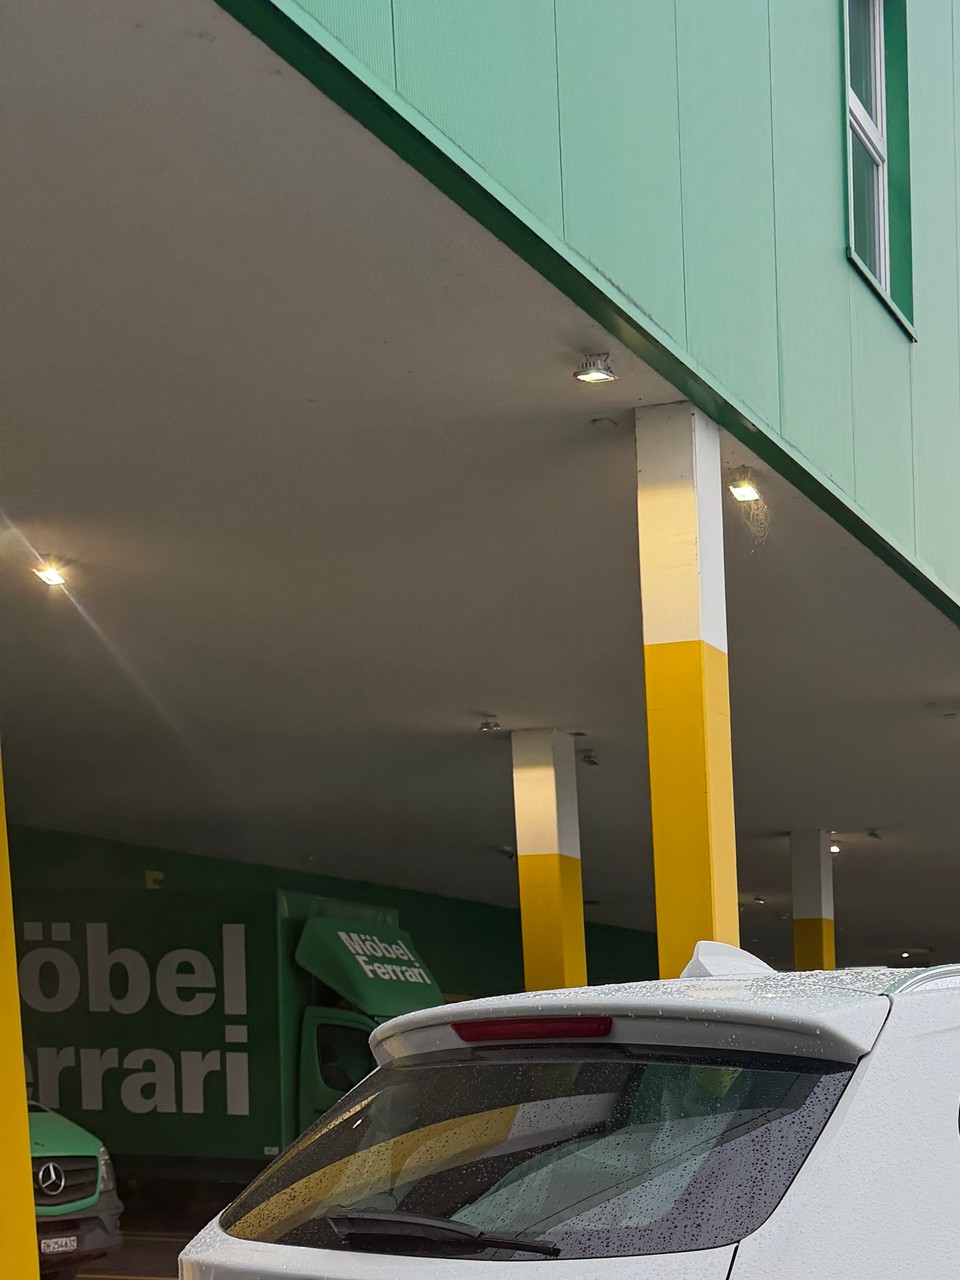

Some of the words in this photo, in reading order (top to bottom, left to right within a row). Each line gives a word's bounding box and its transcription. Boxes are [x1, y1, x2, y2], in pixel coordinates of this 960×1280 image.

[20, 922, 248, 1015] öbel
[338, 931, 414, 962] Möbel
[355, 955, 431, 985] Ferrari
[24, 1025, 250, 1116] rrari
